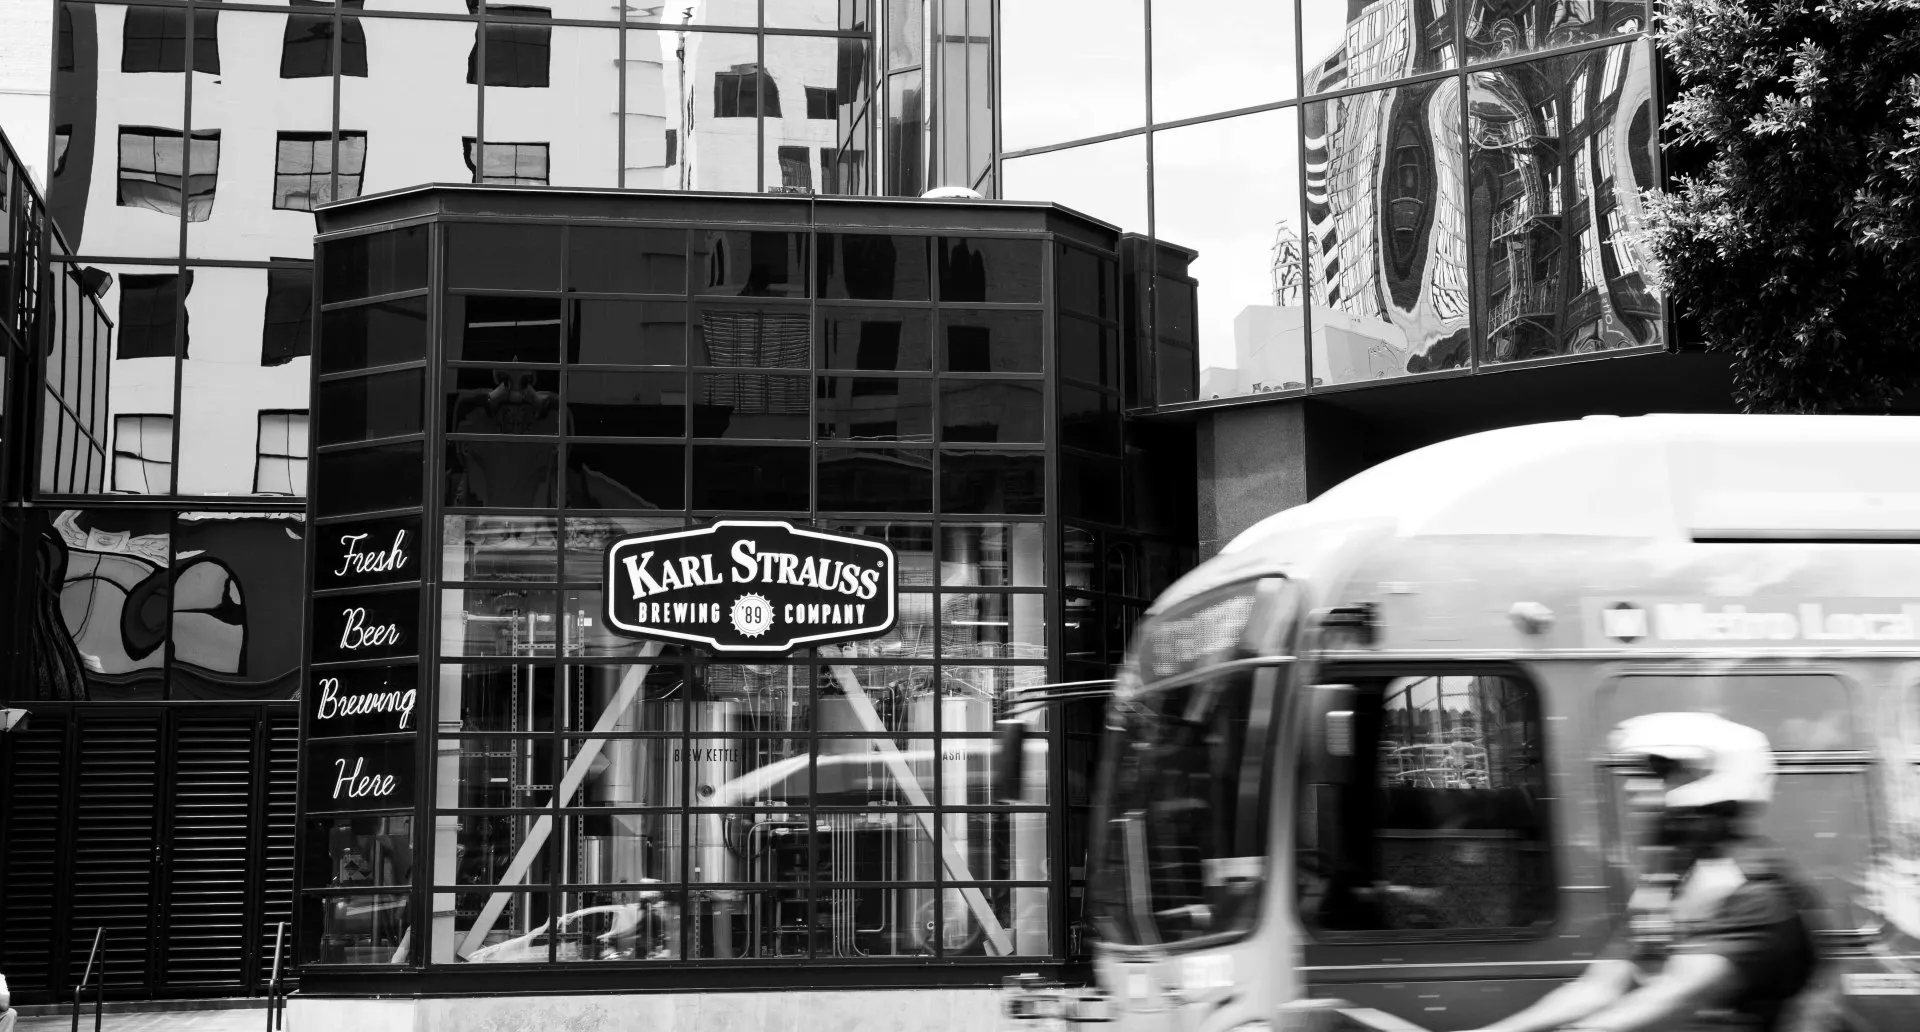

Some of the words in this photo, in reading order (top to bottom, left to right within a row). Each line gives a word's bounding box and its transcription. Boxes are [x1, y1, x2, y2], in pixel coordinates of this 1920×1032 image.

[335, 530, 407, 576] Fresh
[622, 551, 723, 600] KARL
[731, 539, 880, 600] STRAUSS
[340, 608, 399, 649] Beer
[639, 602, 719, 623] BREWING
[785, 604, 865, 624] COMPANY
[318, 678, 416, 729] Brewing
[706, 748, 738, 762] KETTLE
[333, 757, 395, 798] Here
